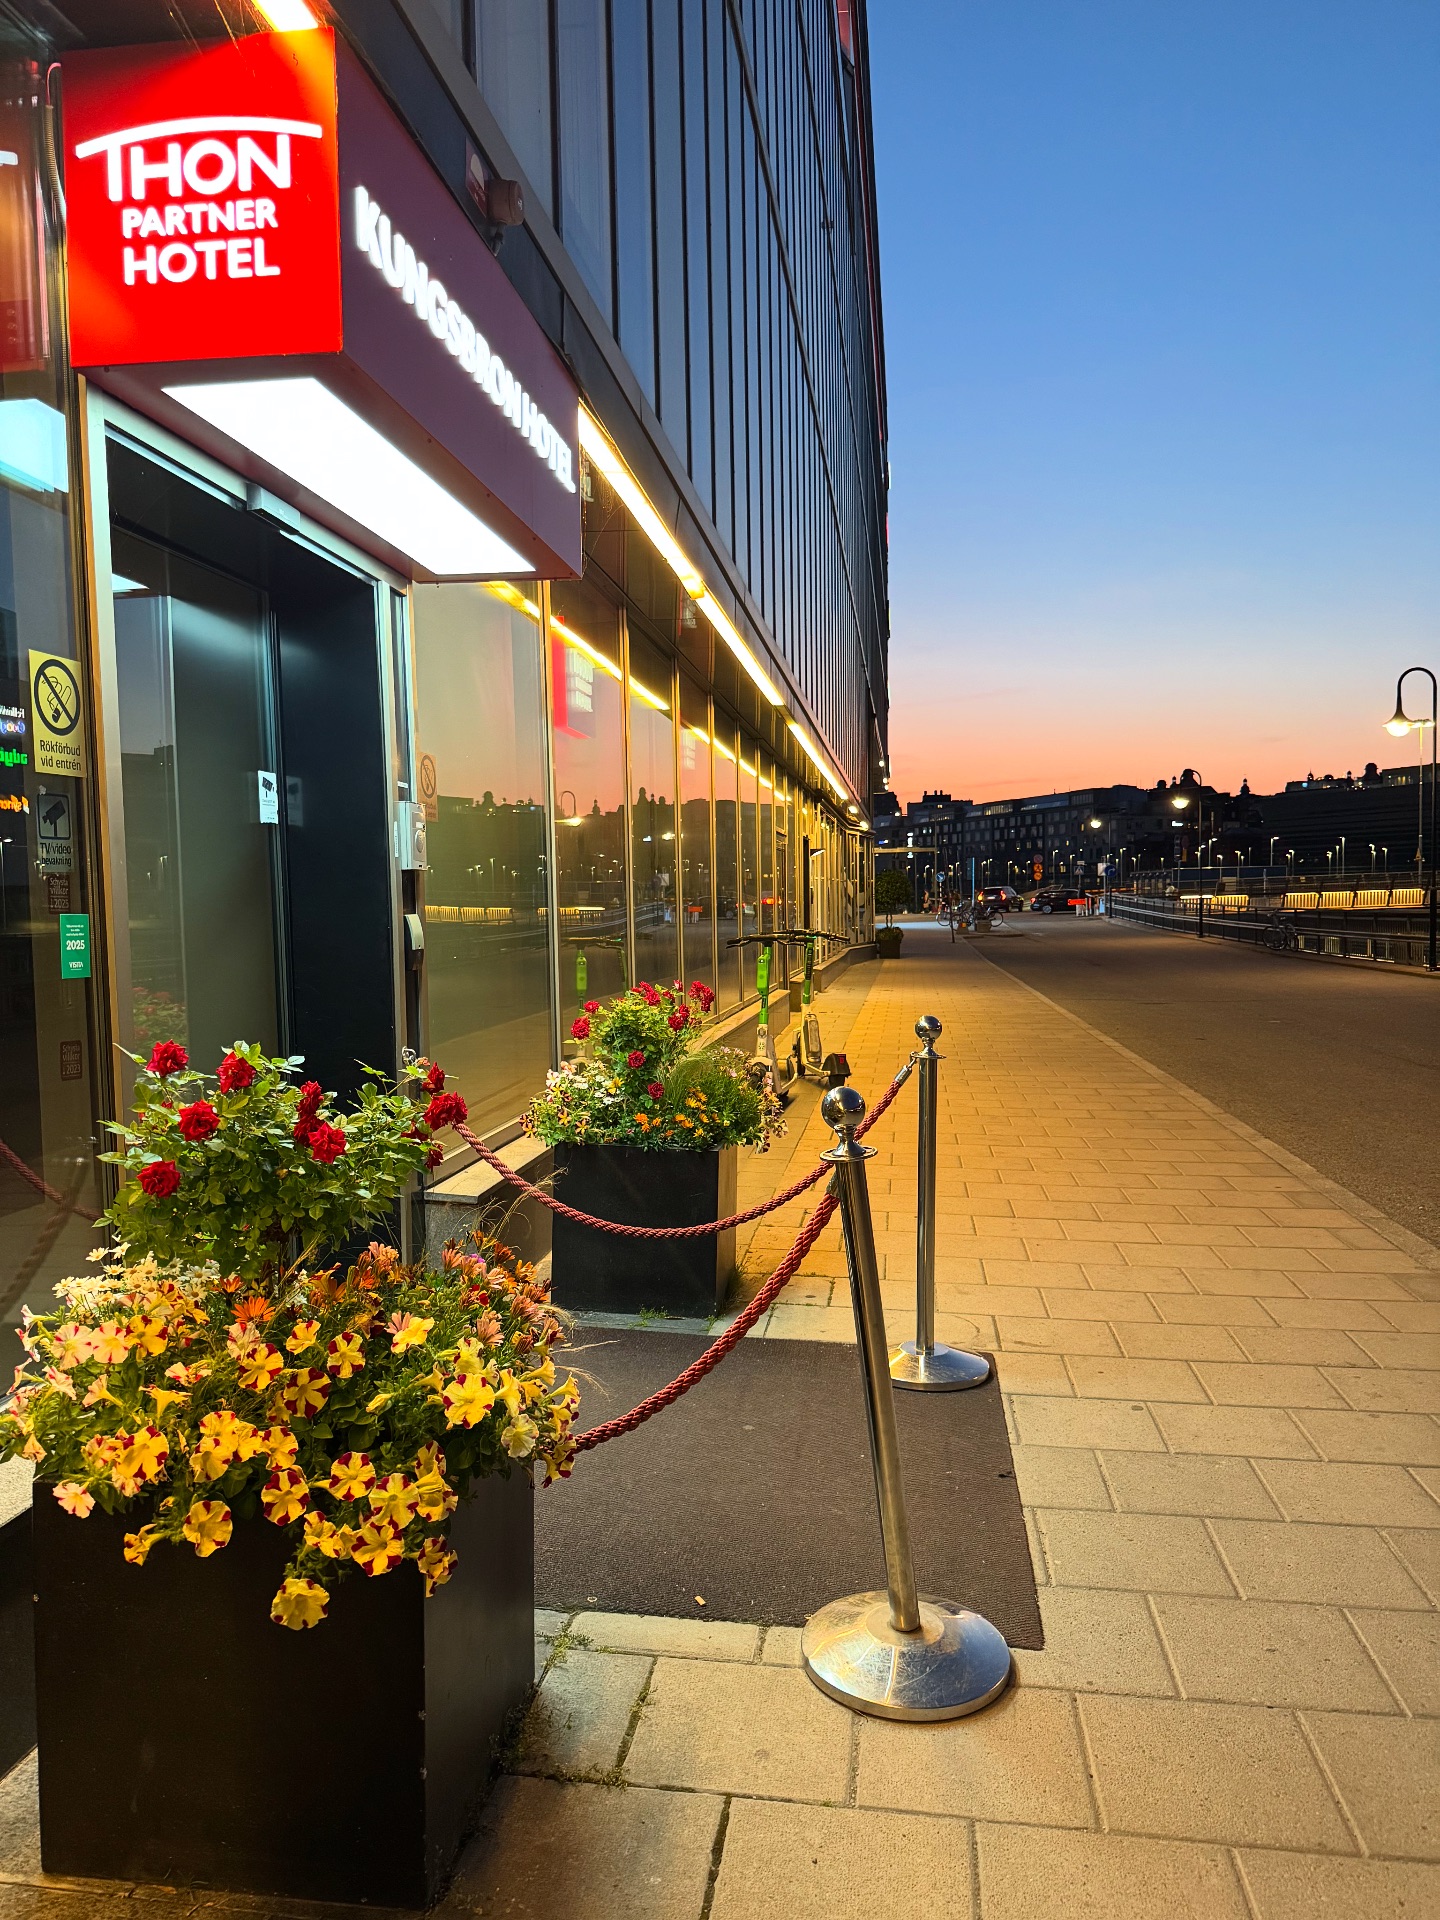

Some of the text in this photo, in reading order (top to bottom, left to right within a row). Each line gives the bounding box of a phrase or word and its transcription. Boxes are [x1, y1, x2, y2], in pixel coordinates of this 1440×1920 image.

[76, 116, 322, 202] THON
[122, 197, 278, 239] PARTNER
[123, 237, 281, 286] HOTEL
[354, 185, 576, 494] KUNGSBRON HOTEL
[40, 740, 81, 757] Rökförbud
[41, 756, 81, 771] vid entrén
[41, 856, 71, 867] bevakning
[66, 940, 85, 950] 2025
